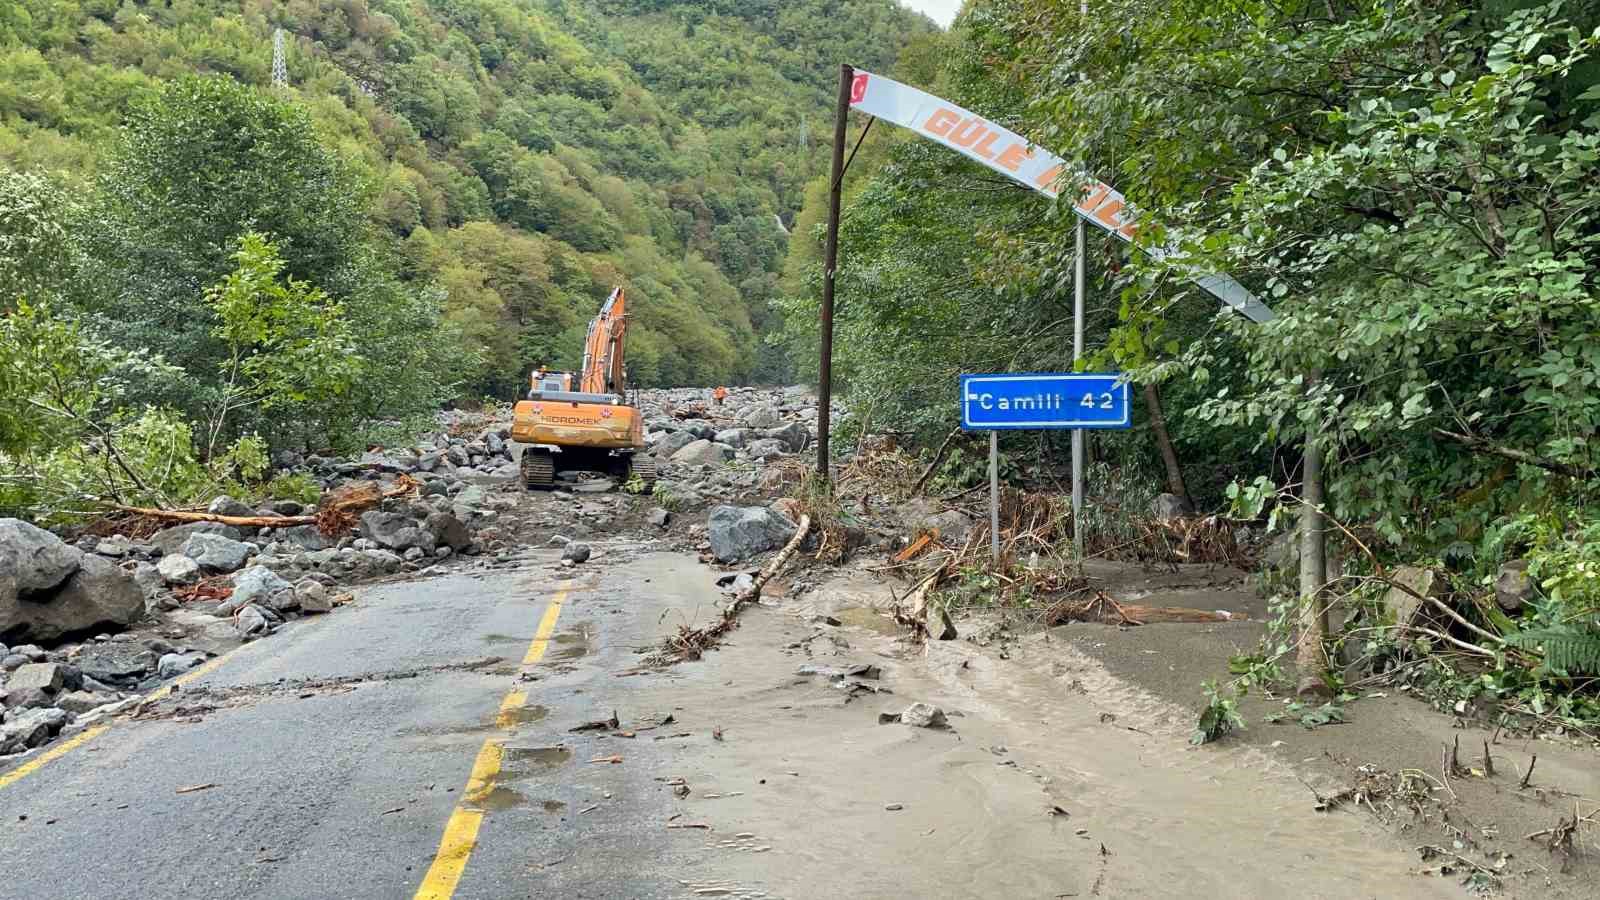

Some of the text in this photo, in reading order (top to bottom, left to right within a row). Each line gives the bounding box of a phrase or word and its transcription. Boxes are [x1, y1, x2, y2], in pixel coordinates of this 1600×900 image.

[924, 107, 1035, 171] GÜLE
[980, 393, 1114, 410] Camili 42
